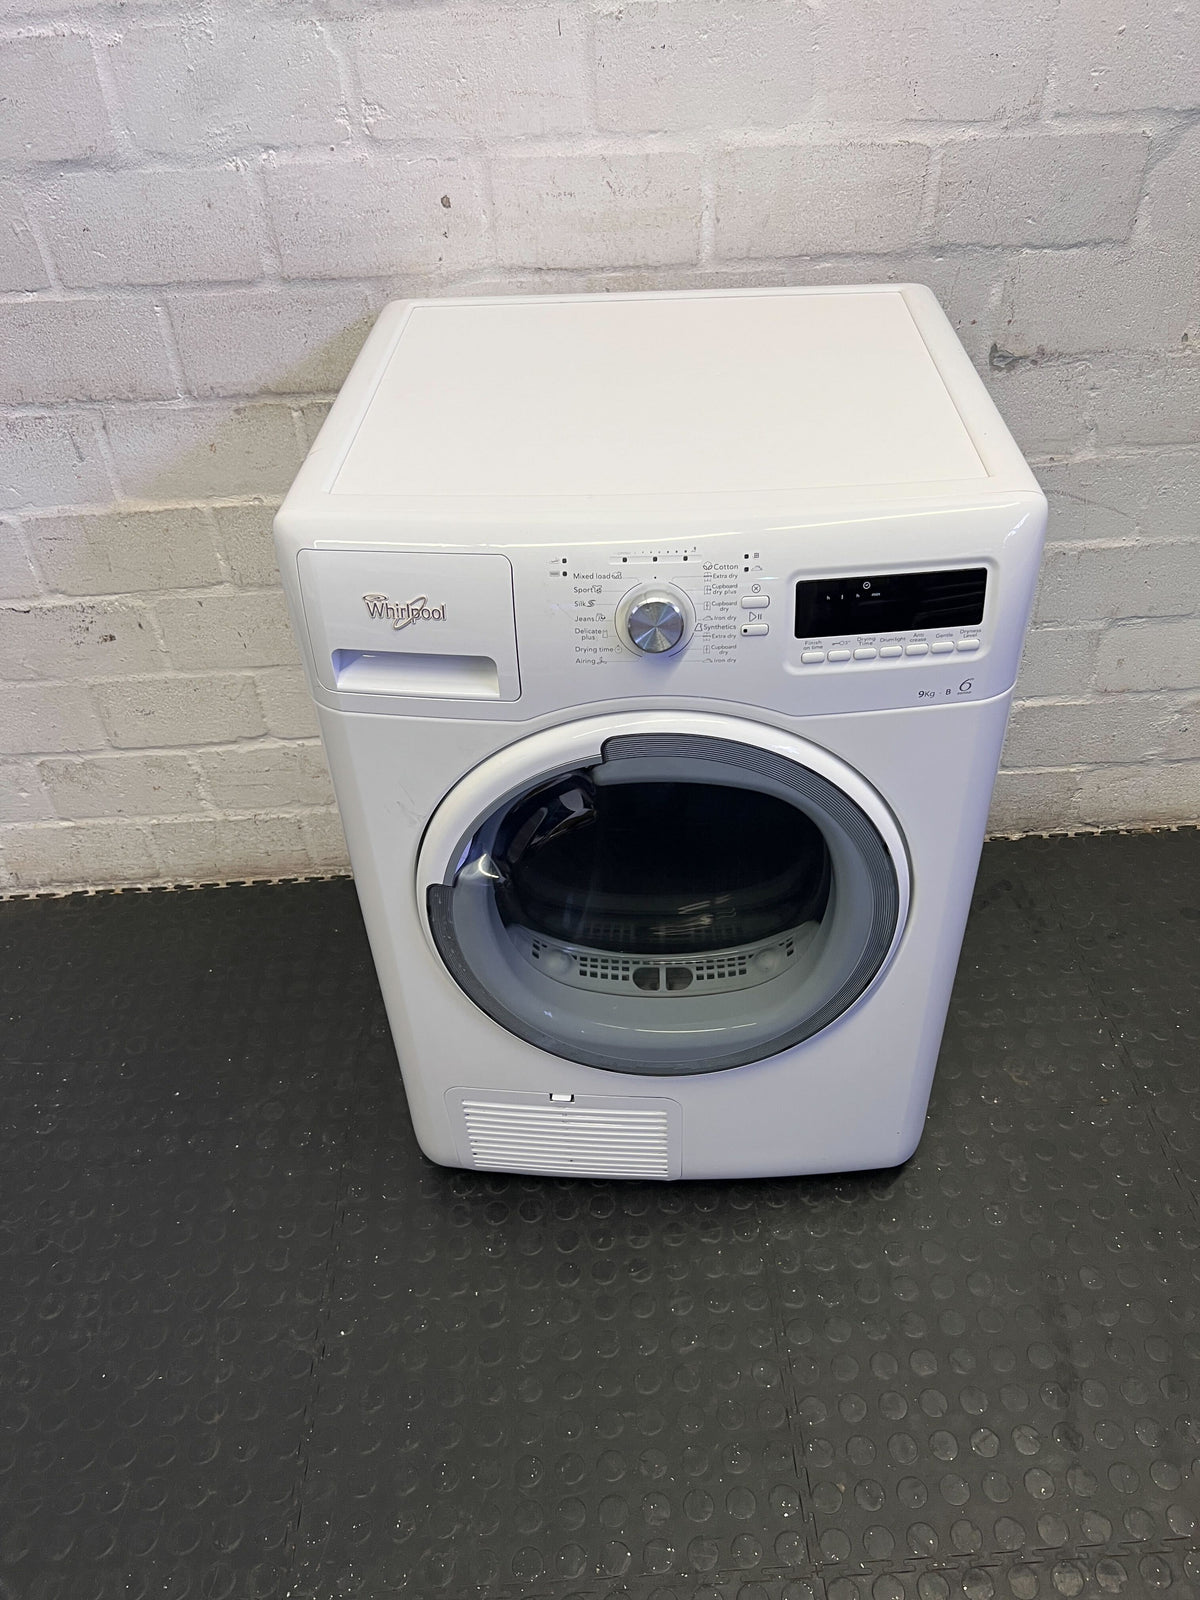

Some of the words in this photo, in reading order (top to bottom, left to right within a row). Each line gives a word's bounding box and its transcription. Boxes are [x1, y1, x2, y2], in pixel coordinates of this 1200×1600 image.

[573, 586, 593, 595] Sport
[366, 601, 447, 625] Whirlpool
[918, 690, 936, 698] 9Kg
